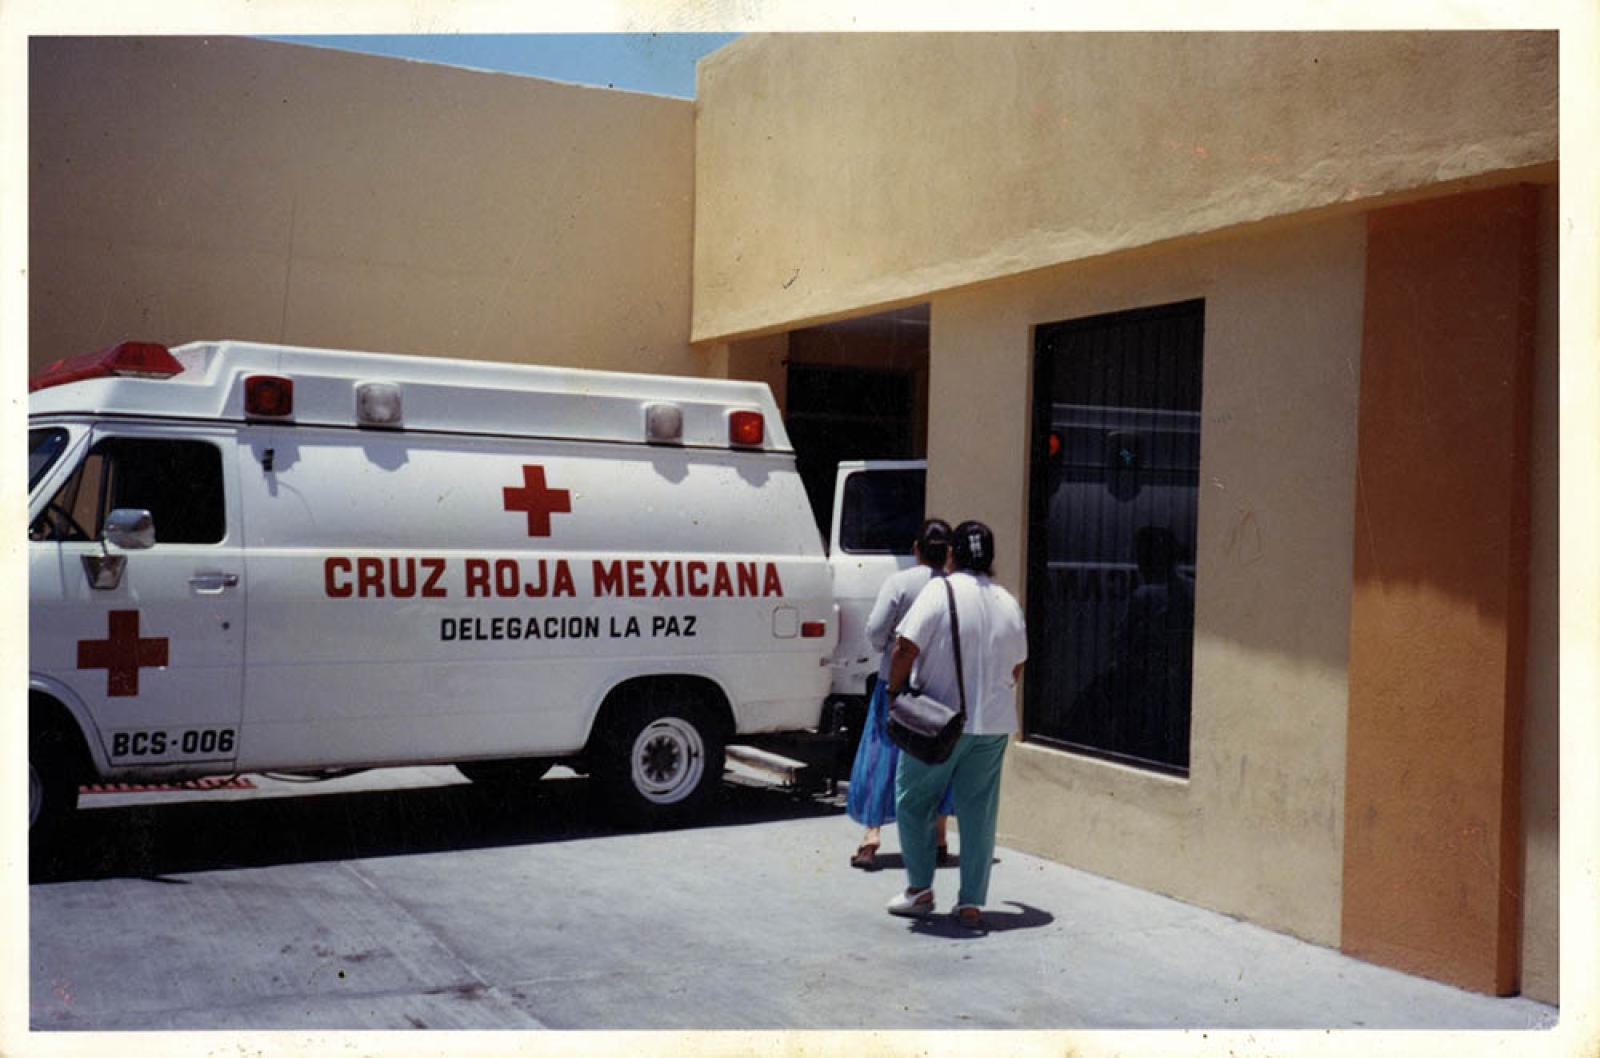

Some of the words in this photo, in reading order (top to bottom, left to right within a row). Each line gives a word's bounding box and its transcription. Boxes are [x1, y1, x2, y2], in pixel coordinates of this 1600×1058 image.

[324, 557, 447, 598] CRUZ
[465, 559, 577, 598] ROJA
[592, 561, 784, 598] MEXICANA
[440, 616, 599, 642] DELEGACION
[609, 617, 641, 638] LA
[651, 616, 697, 638] PAZ
